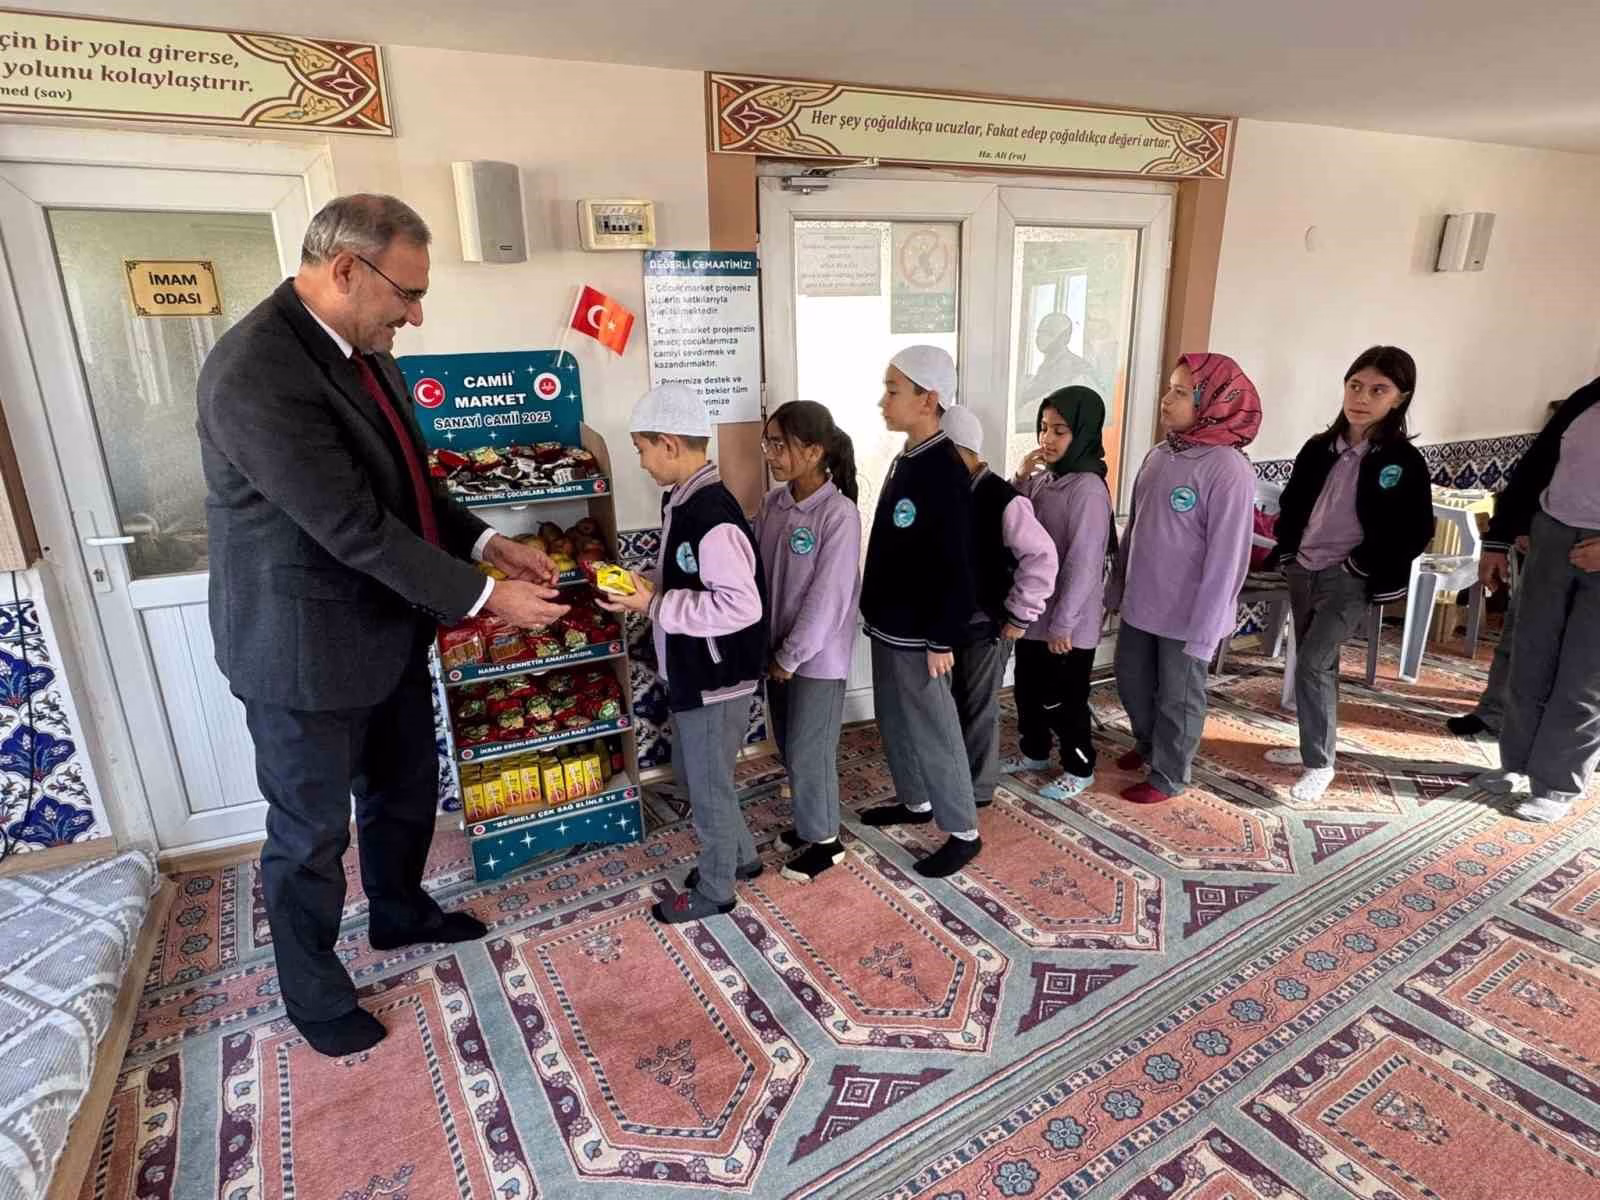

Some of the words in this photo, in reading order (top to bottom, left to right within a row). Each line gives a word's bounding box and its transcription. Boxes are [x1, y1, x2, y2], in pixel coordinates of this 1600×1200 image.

[46, 33, 83, 53] bir
[88, 40, 142, 59] yola
[148, 44, 239, 69] girerse,
[2, 59, 94, 79] yolunu
[101, 64, 254, 92] kolaylaştırır.
[34, 86, 73, 102] (sav)
[811, 109, 837, 126] Her
[864, 114, 933, 136] çoğaldıkça
[935, 119, 983, 137] ucuzlar,
[986, 123, 1019, 139] Fakat
[1021, 126, 1048, 143] edep
[1050, 129, 1106, 146] çoğaldıkça
[1108, 131, 1142, 149] değeri
[1142, 137, 1171, 149] artar.
[649, 257, 691, 270] DEĞERLİ
[692, 258, 753, 270] CEMAATİMİZ!
[148, 271, 198, 286] İMAM
[685, 284, 714, 292] market
[715, 283, 752, 294] projemiz
[153, 293, 202, 305] ODASI
[682, 326, 711, 335] market
[713, 325, 756, 337] projemizin
[683, 348, 724, 357] sevdirmek
[463, 372, 513, 388] CAMİİ
[704, 376, 731, 384] destek
[732, 385, 749, 393] tüm
[455, 393, 527, 409] MARKET
[434, 412, 482, 431] SANAYİ
[485, 410, 520, 428] CAMİİ
[522, 411, 552, 424] 2025
[478, 665, 505, 674] NAMAZ
